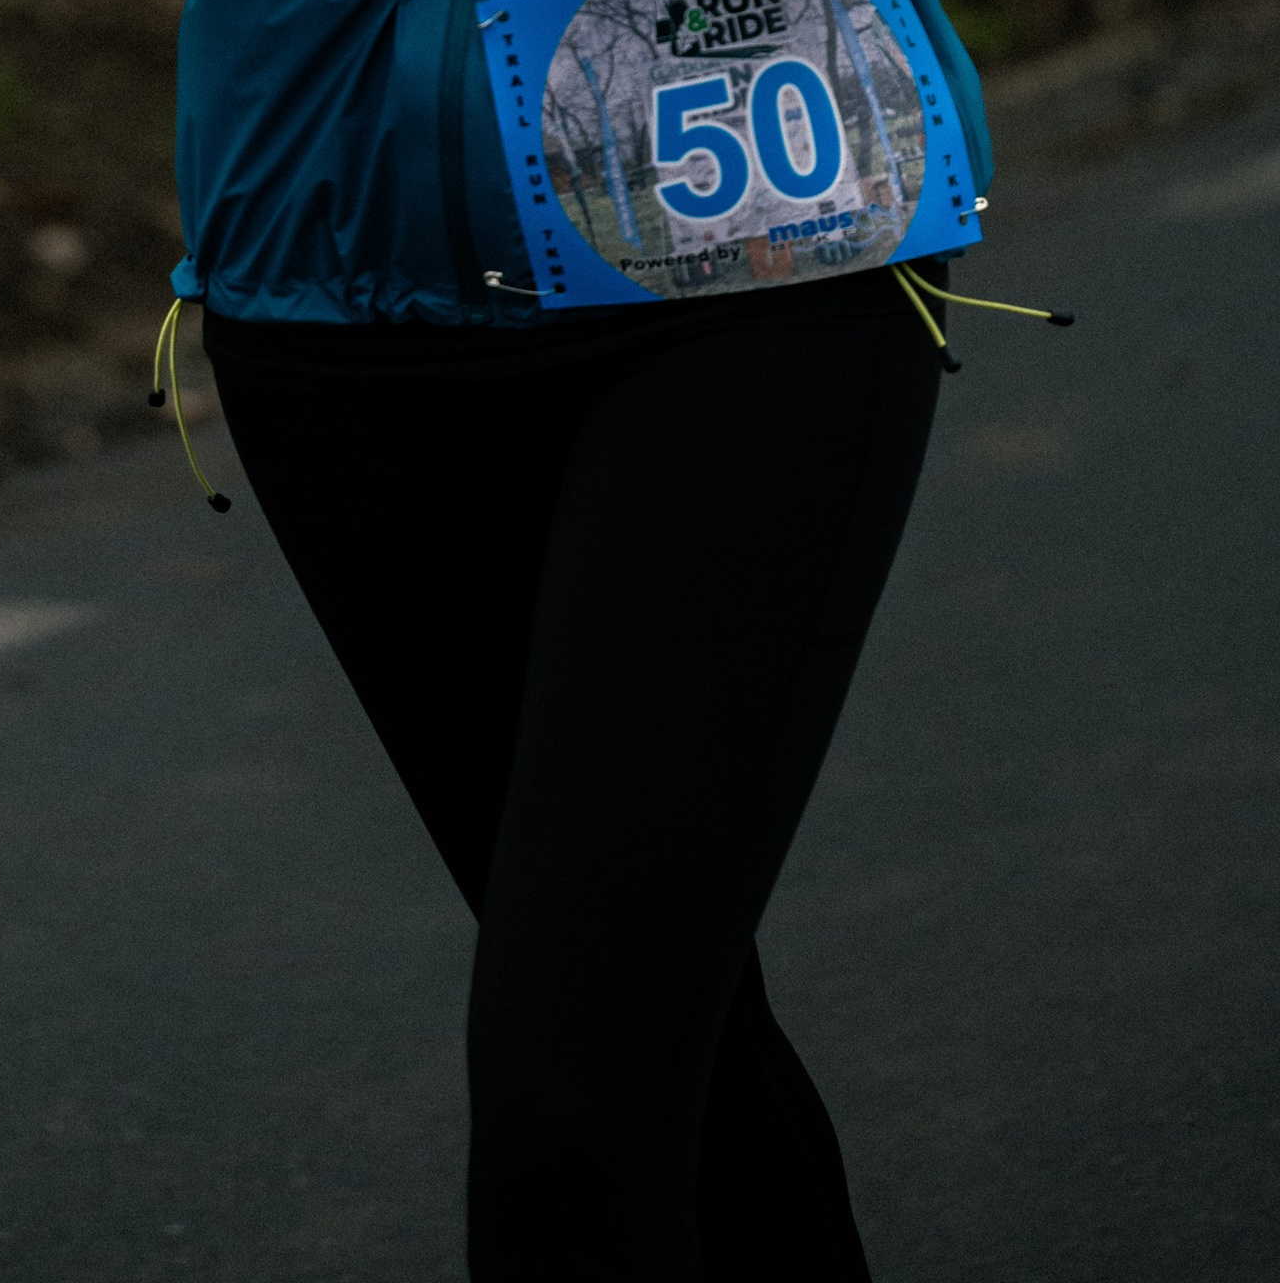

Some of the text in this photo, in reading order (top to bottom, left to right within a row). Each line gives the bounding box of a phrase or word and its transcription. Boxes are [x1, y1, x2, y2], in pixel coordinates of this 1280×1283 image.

[686, 7, 787, 48] & RIDE
[503, 33, 530, 128] TRAIL
[526, 154, 547, 204] RUN
[920, 74, 944, 126] RUN
[654, 58, 844, 218] 50
[769, 211, 854, 243] maus
[619, 245, 741, 271] Powered by
